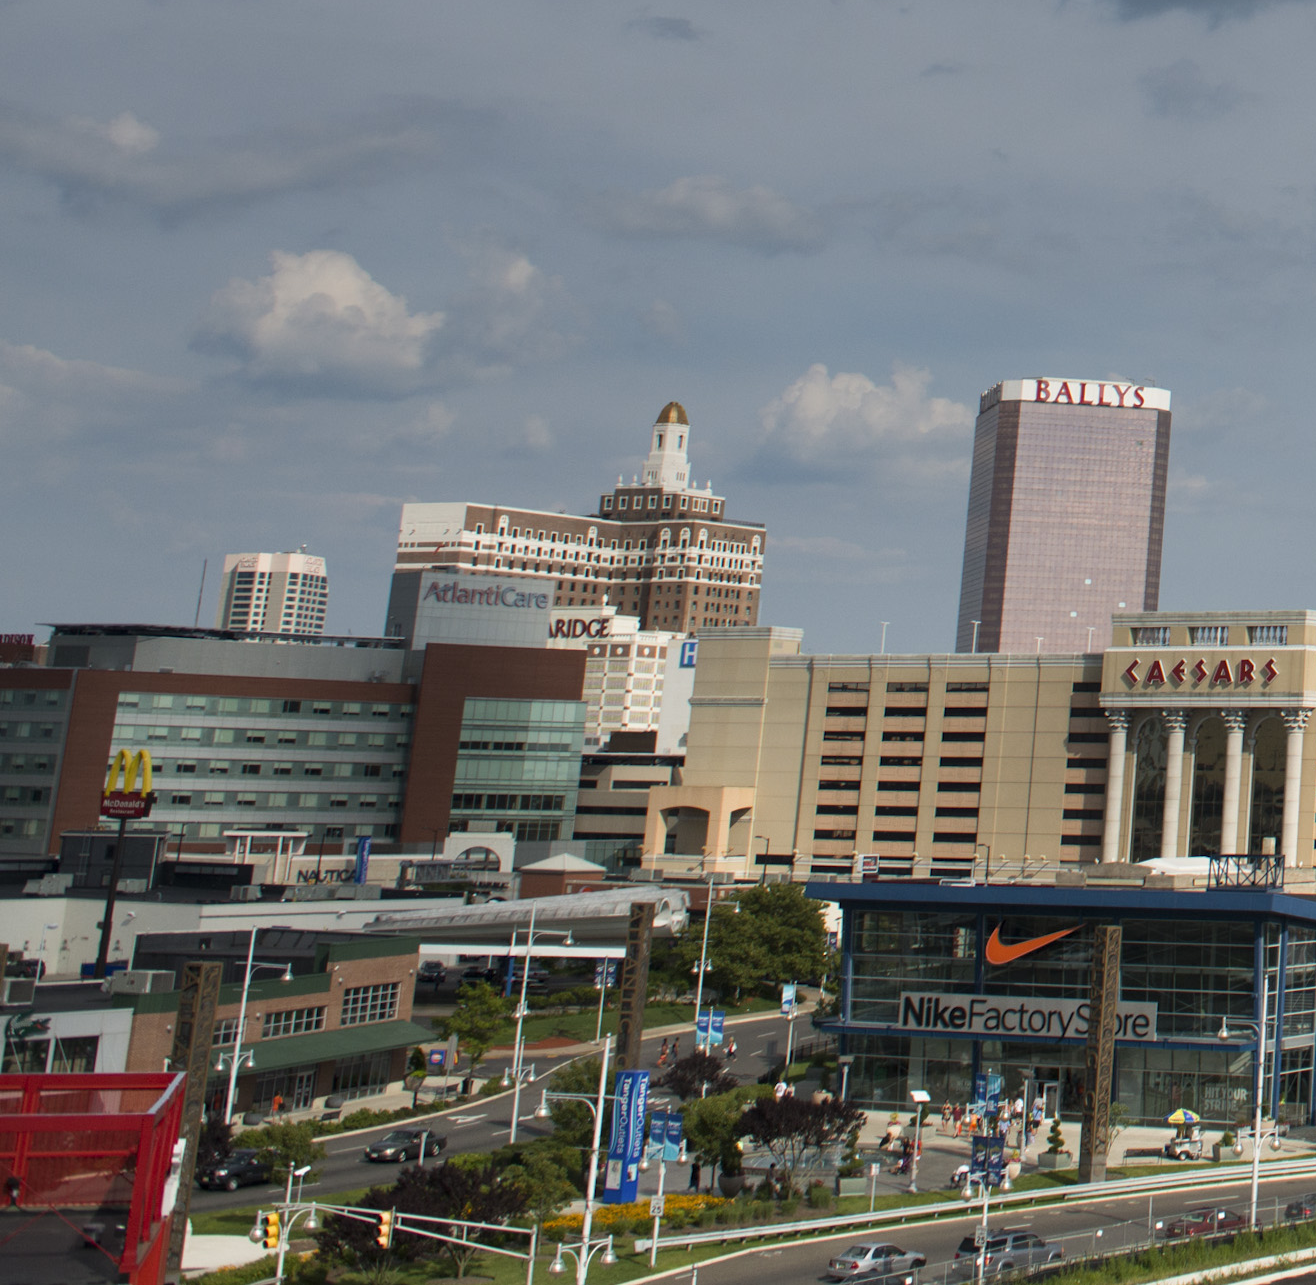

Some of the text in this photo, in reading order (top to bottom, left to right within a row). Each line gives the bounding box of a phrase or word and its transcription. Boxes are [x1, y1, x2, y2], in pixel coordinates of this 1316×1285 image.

[1035, 380, 1145, 408] BALLYS
[423, 581, 549, 609] AtlantiCare
[0, 634, 34, 645] DISON
[1125, 658, 1280, 685] CAESARS
[103, 799, 145, 808] McDonald's
[902, 996, 1149, 1043] NikeFactorySre
[1204, 1086, 1247, 1101] HIT YOUR
[651, 1205, 662, 1213] 25
[976, 1236, 985, 1245] 25
